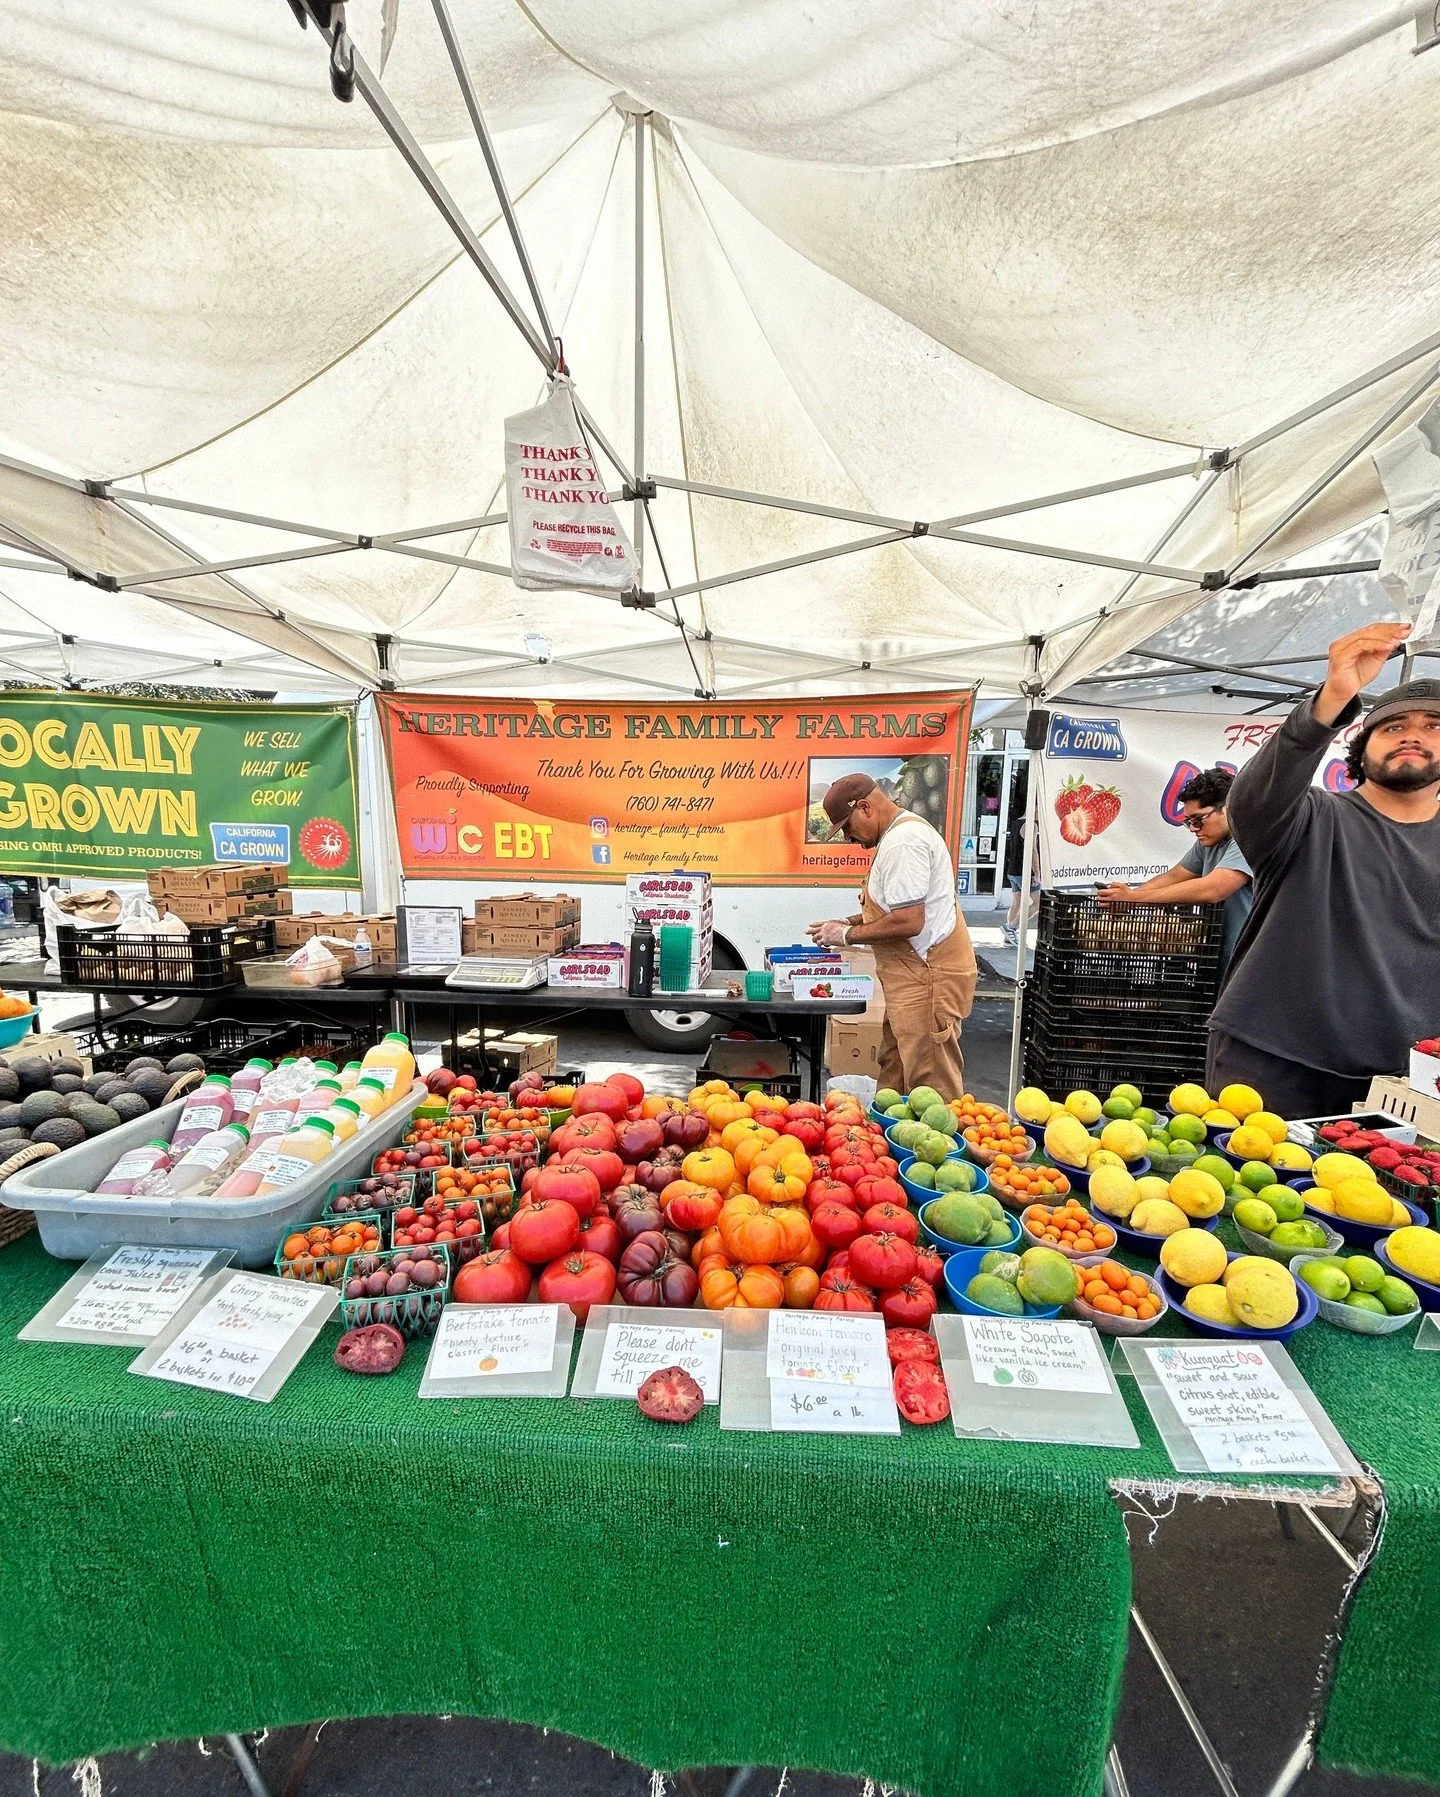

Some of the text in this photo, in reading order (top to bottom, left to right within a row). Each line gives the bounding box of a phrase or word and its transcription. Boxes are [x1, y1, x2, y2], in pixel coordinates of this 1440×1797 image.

[521, 444, 582, 462] THANK
[521, 467, 583, 482] THANK
[522, 486, 585, 504] THANK
[532, 519, 616, 537] PLEASE RECYCLE THIS BAG.
[398, 711, 948, 740] HERITAGE FAMILY FARMS
[243, 730, 300, 749] WE SELL
[1053, 729, 1121, 751] CA GROWN
[241, 759, 310, 779] WHAT WE
[536, 758, 805, 789] Thank You For Growing With Us!!!
[416, 775, 530, 802] Proudly Supporting
[251, 789, 302, 807] GROW.
[625, 794, 716, 813] (760) 741-8471
[0, 781, 199, 838] GROWN
[226, 827, 277, 839] CALIFORNIA
[320, 831, 342, 846] 365
[494, 821, 553, 861] EBT
[32, 842, 63, 852] OMRI
[66, 844, 125, 857] APPROVED
[127, 846, 202, 860] PRODUCTS!
[219, 841, 285, 858] CA GROWN
[623, 851, 719, 865] Heritage Family Farms
[638, 880, 693, 892] CARLSBAD
[560, 964, 611, 975] CARLSBAD
[112, 1250, 154, 1269] Freshly
[125, 1269, 161, 1279] Juices
[230, 1283, 308, 1307] Cherry Tomatoes
[616, 1331, 657, 1349] Please
[970, 1321, 1073, 1350] White Sapote
[219, 1348, 260, 1363] basket
[448, 1348, 483, 1358] classic
[613, 1350, 703, 1369] squeeze me
[830, 1346, 856, 1361] juicy
[975, 1354, 994, 1363] like
[999, 1356, 1032, 1365] vanilla
[1035, 1358, 1048, 1367] ice
[1052, 1349, 1076, 1357] sweet
[1178, 1349, 1235, 1370] Kumquat
[157, 1358, 170, 1369] 2
[169, 1361, 206, 1379] baskets
[781, 1355, 821, 1369] tomato
[611, 1368, 633, 1384] till
[1210, 1372, 1229, 1382] and
[1233, 1372, 1259, 1381] sour
[1246, 1387, 1280, 1400] edible
[833, 1405, 865, 1418] a lb.
[1187, 1403, 1221, 1416] sweet
[1220, 1432, 1271, 1445] 2 baskets
[1250, 1454, 1276, 1465] each
[1278, 1452, 1310, 1464] basket
